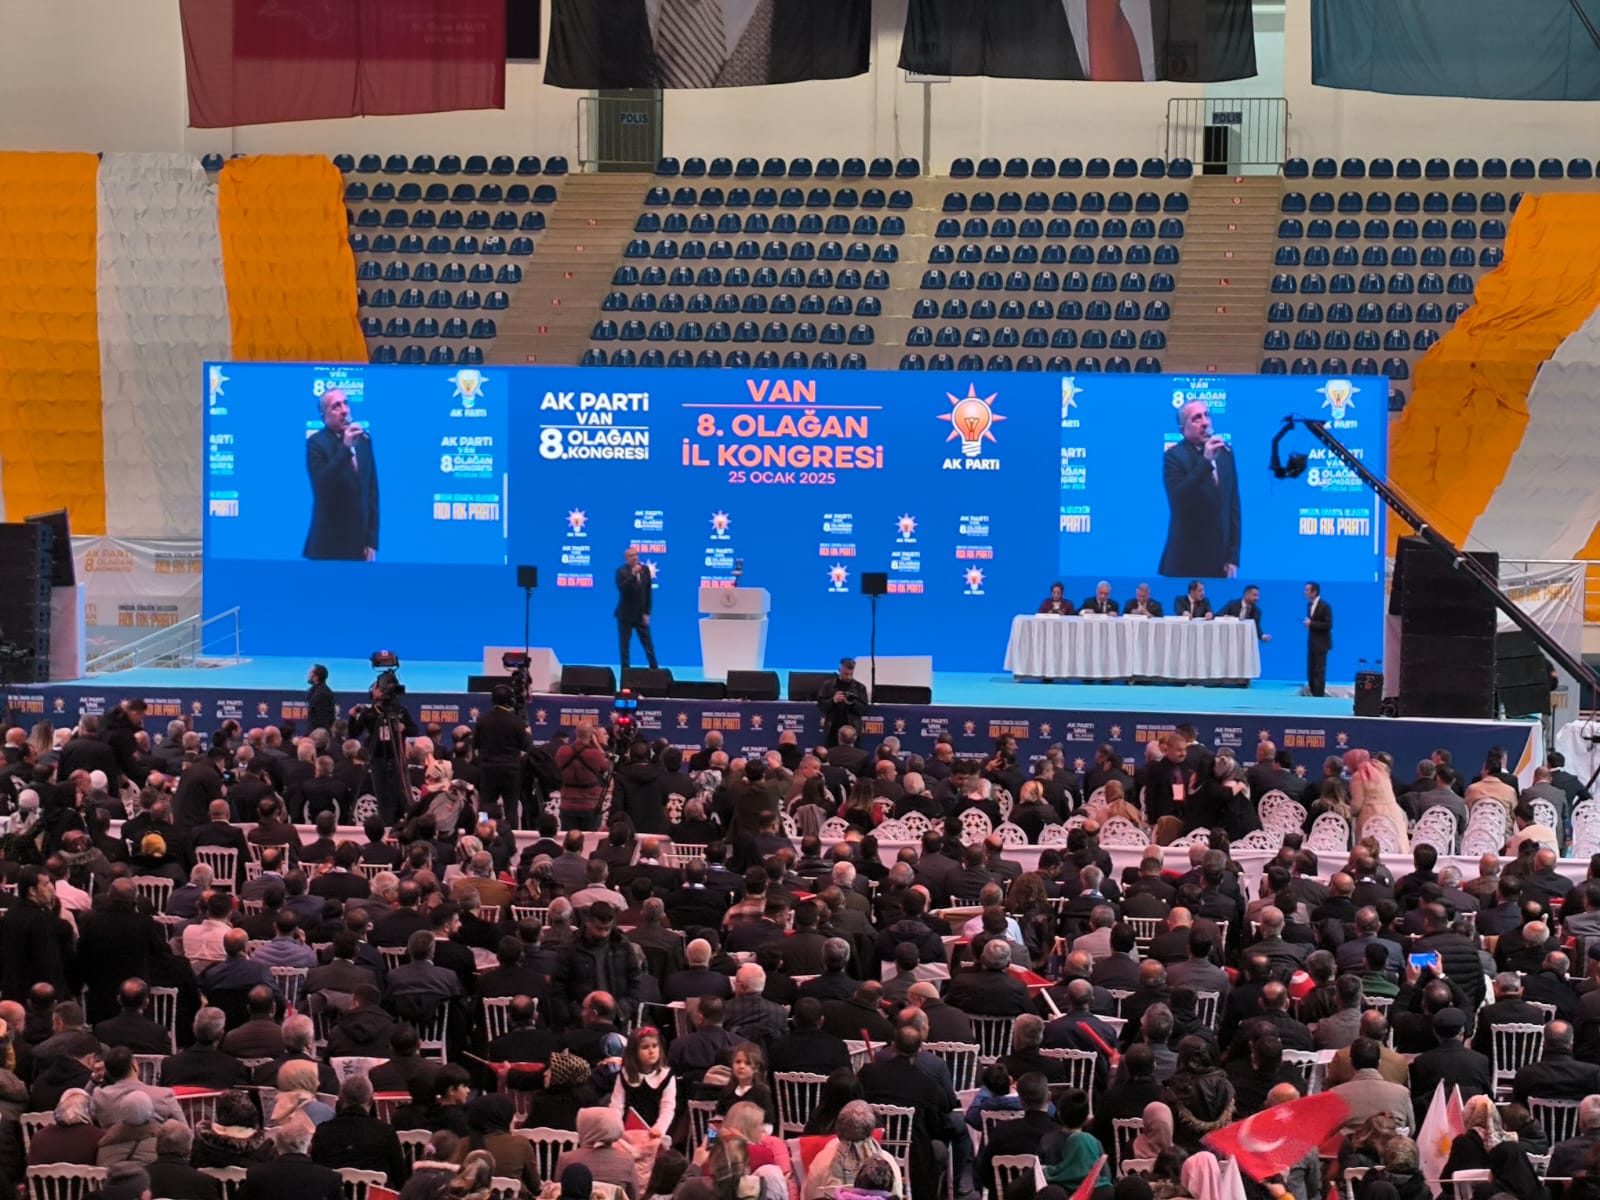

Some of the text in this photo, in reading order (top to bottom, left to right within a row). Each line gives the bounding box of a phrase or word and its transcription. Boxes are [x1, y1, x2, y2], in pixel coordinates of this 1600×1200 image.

[540, 393, 574, 411] AK
[746, 379, 817, 404] VAN
[576, 412, 613, 425] VAN
[697, 408, 868, 439] 8. OLAĞAN
[539, 428, 649, 460] 8. OLAĞAN
[682, 438, 884, 469] İL KONGRESİ
[942, 459, 963, 470] AK
[728, 471, 836, 485] 25 OCAK 2025
